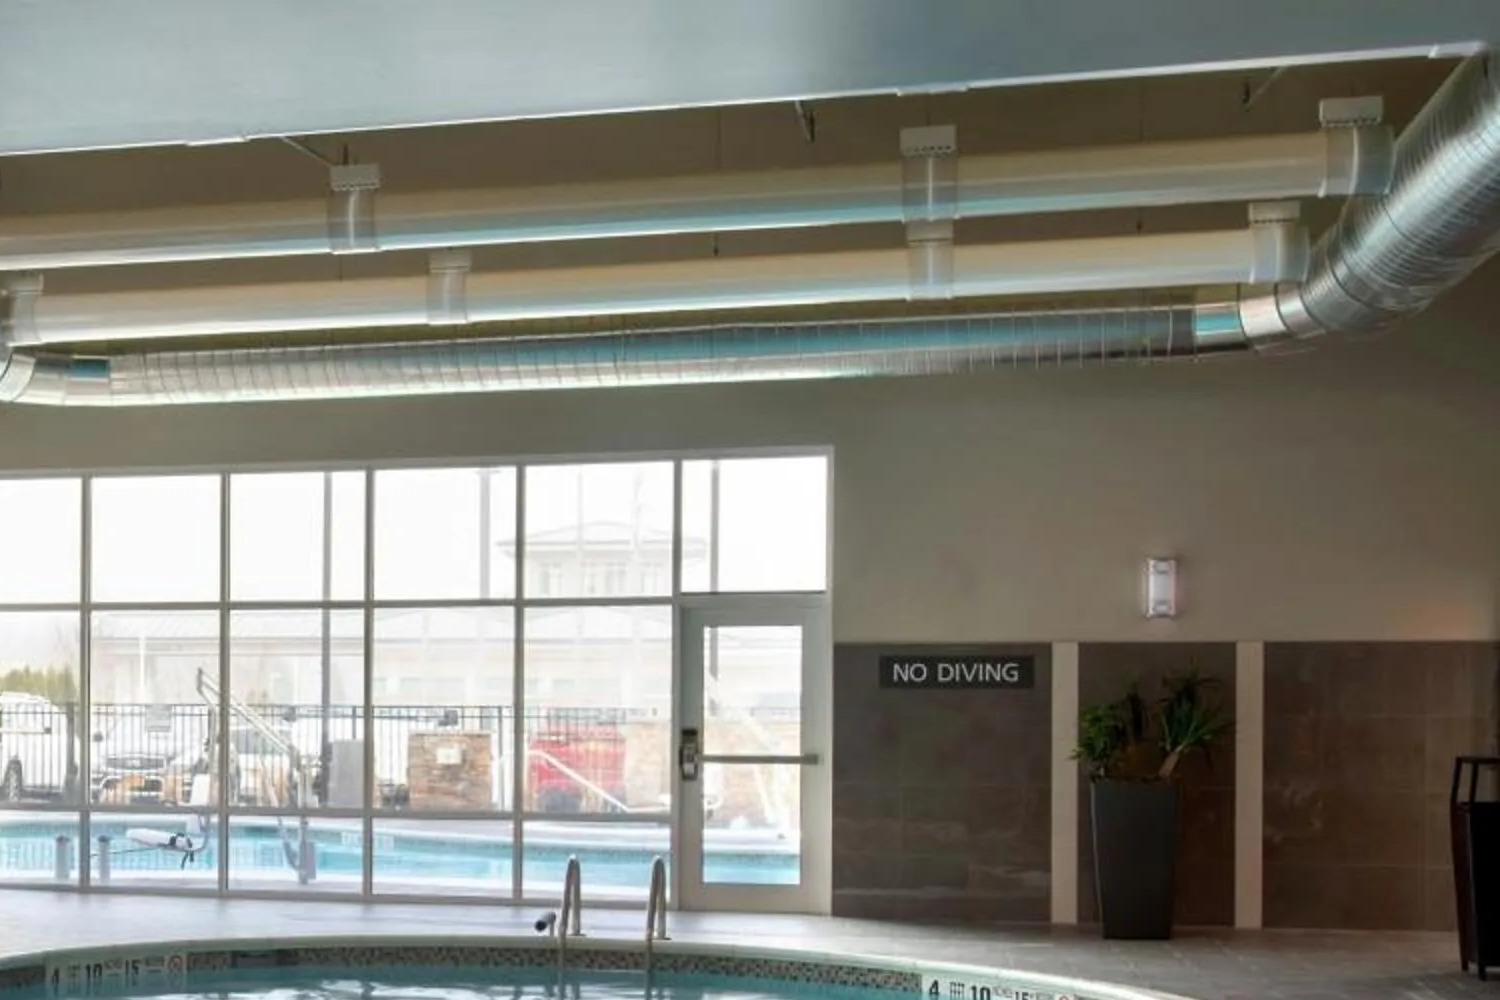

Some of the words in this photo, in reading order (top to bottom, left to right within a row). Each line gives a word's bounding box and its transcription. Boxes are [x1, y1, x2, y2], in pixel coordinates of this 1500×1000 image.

[893, 662, 928, 683] NO
[937, 662, 1021, 683] DIVING
[929, 979, 940, 996] 4
